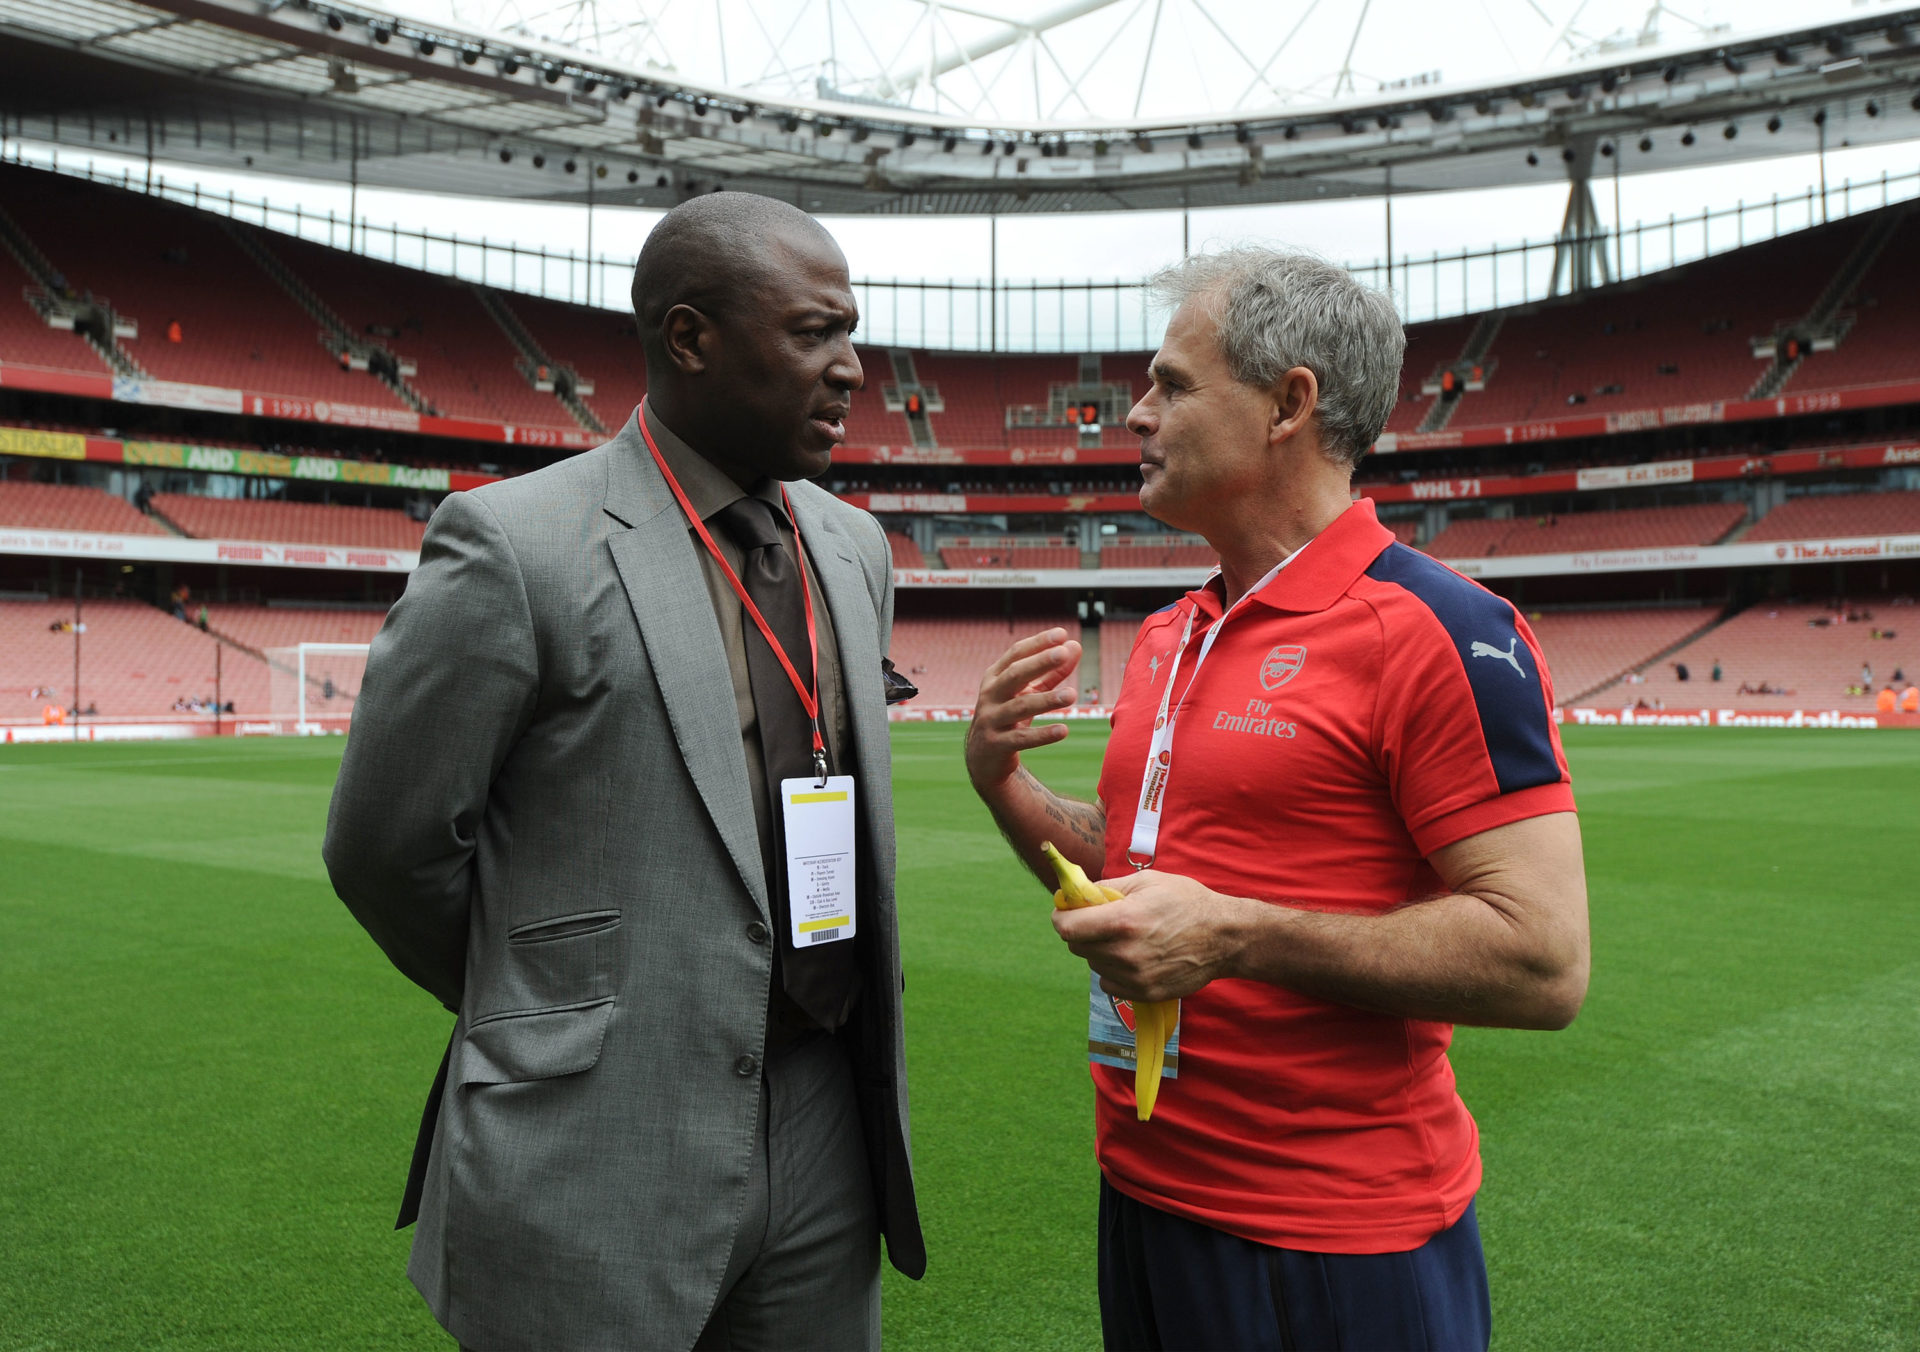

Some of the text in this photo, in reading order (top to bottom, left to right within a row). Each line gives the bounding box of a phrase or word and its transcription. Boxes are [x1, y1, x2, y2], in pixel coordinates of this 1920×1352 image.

[273, 401, 313, 420] 1993
[124, 442, 449, 490] OVER AND OVER AND OVER AGAIN
[1411, 479, 1481, 498] WHL 71
[1793, 545, 1817, 559] The
[1823, 543, 1880, 557] Arsenal
[903, 572, 1037, 584] The Arsenal Foundation
[1246, 698, 1272, 717] Fly
[1212, 710, 1298, 739] Emirates
[1573, 709, 1878, 728] The Arsenal Foundation
[1143, 766, 1161, 811] Foundation
[1151, 767, 1168, 813] The Arsenal
